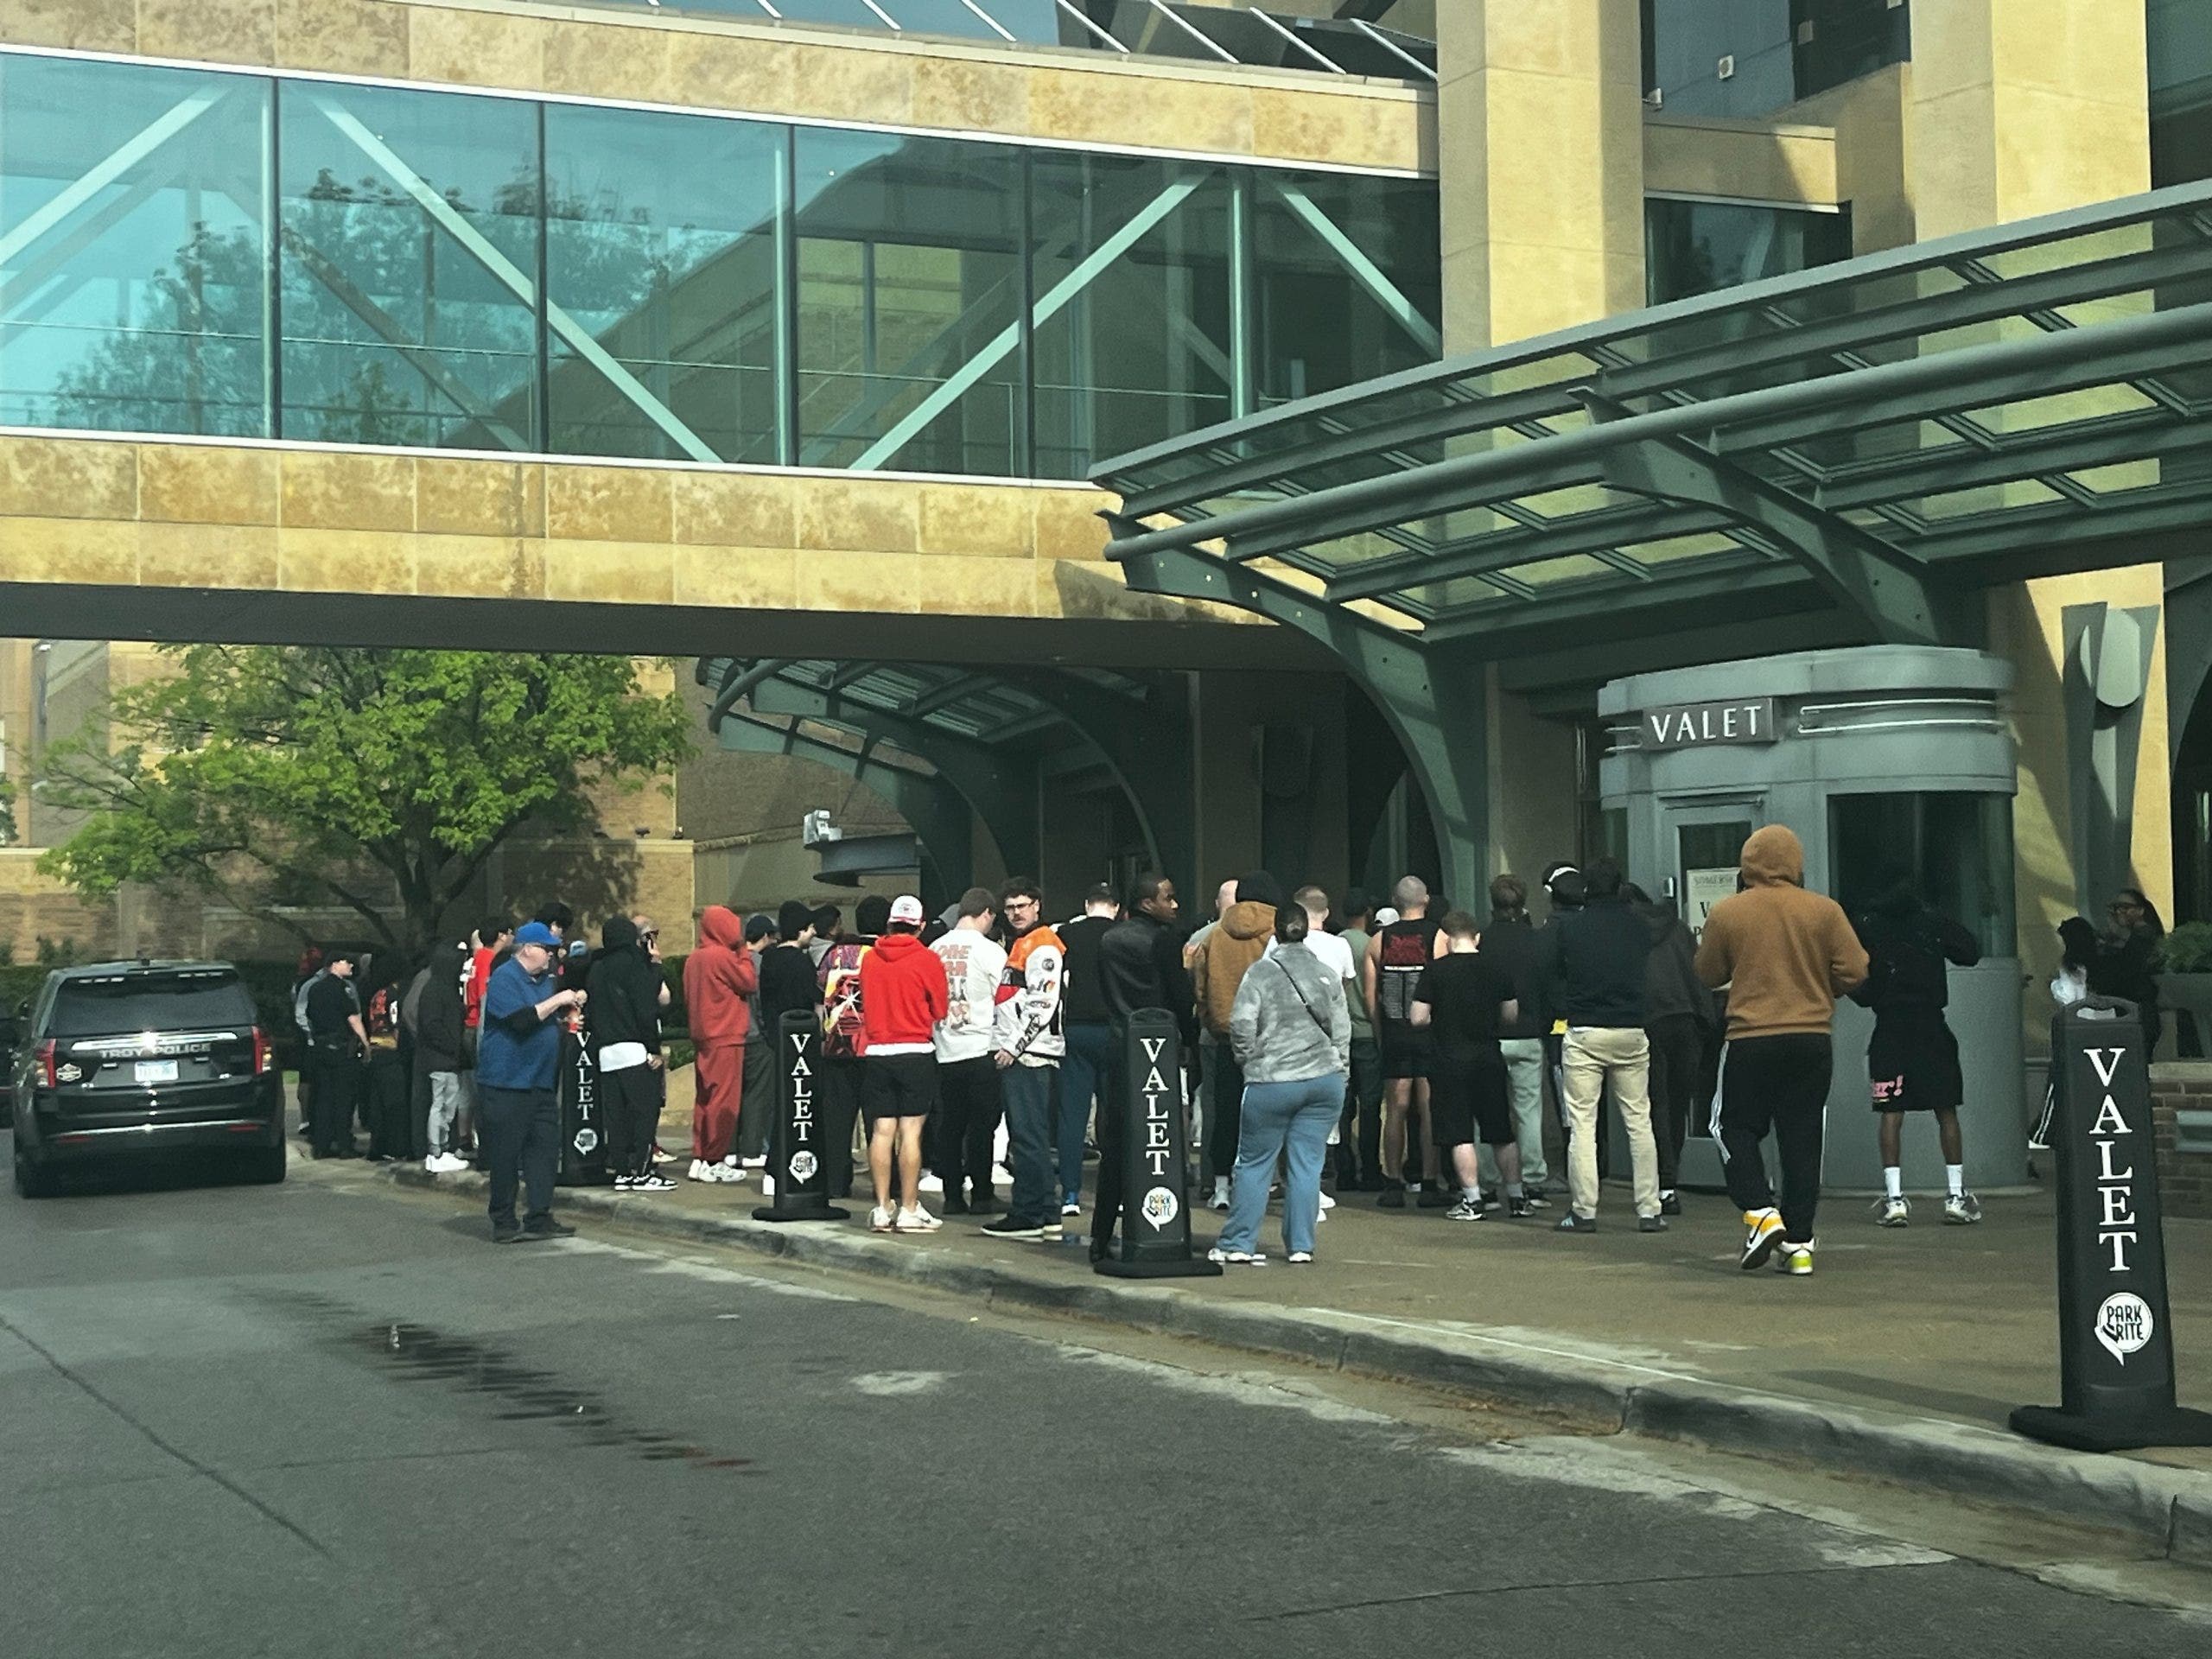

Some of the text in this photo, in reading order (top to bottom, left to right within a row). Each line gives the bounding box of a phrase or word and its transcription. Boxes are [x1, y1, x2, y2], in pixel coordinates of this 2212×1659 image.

[1650, 705, 1762, 743] VALET
[99, 1042, 212, 1058] TROY POLICE
[575, 1030, 594, 1121] VALET
[789, 1033, 813, 1141] VALET
[1140, 1038, 1170, 1176] VALET
[2083, 1047, 2138, 1272] VALET
[2107, 1304, 2142, 1324] PARK
[2116, 1323, 2145, 1341] RITE
